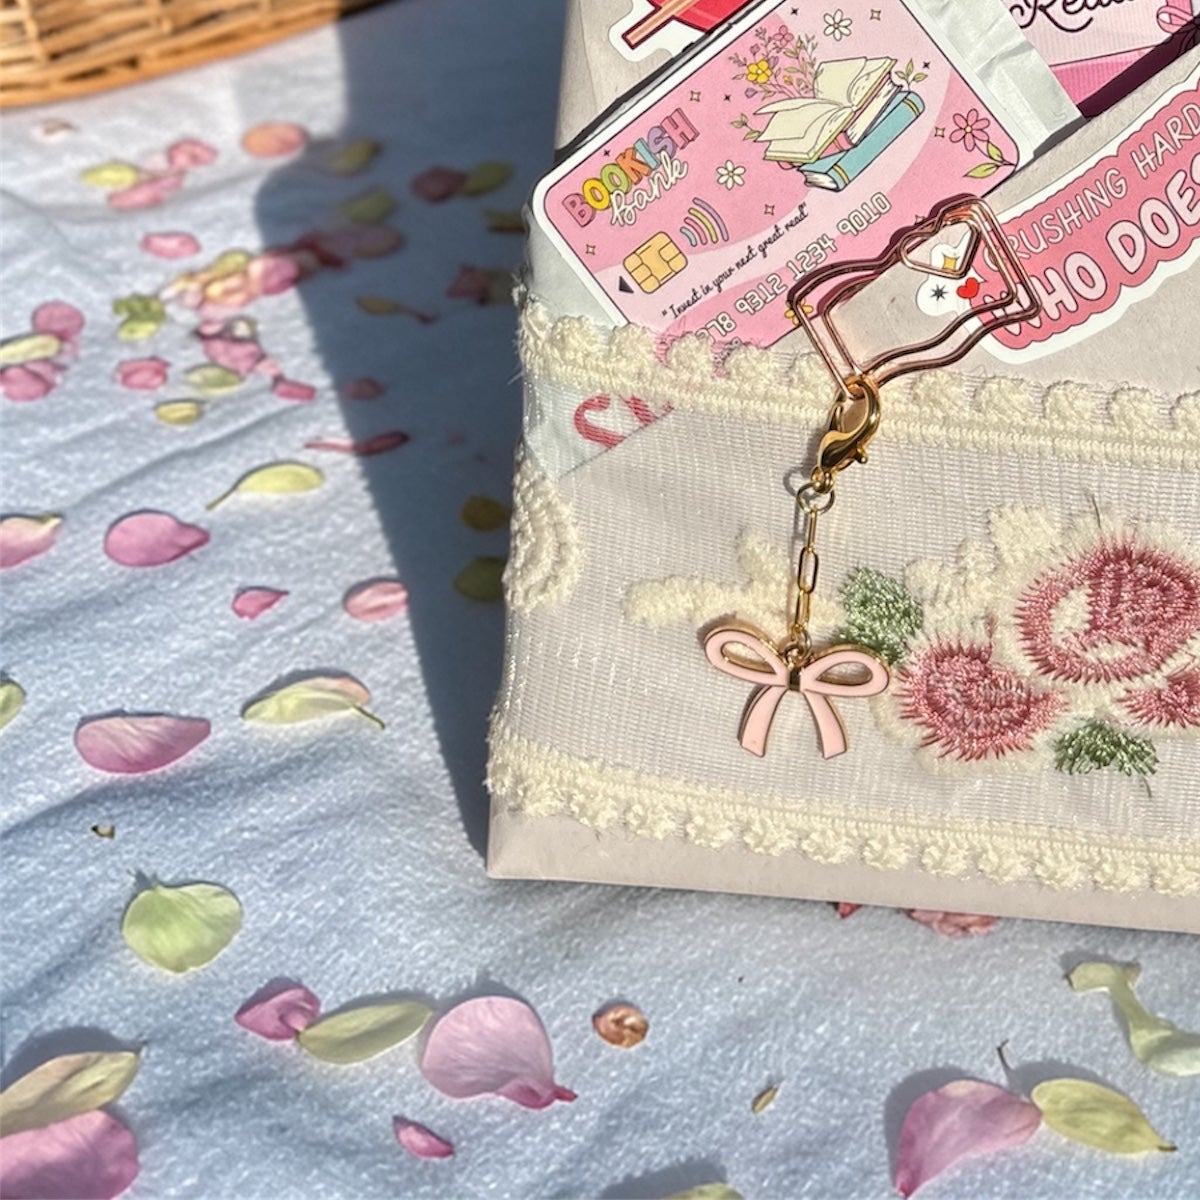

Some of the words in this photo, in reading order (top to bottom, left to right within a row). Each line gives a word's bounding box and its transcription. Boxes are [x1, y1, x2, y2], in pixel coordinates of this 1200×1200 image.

[561, 108, 700, 228] BOOKISH
[712, 267, 735, 294] your
[735, 245, 758, 271] next
[758, 224, 784, 259] great
[734, 274, 788, 315] 9312
[786, 233, 838, 280] 1234
[836, 191, 892, 237] 9010
